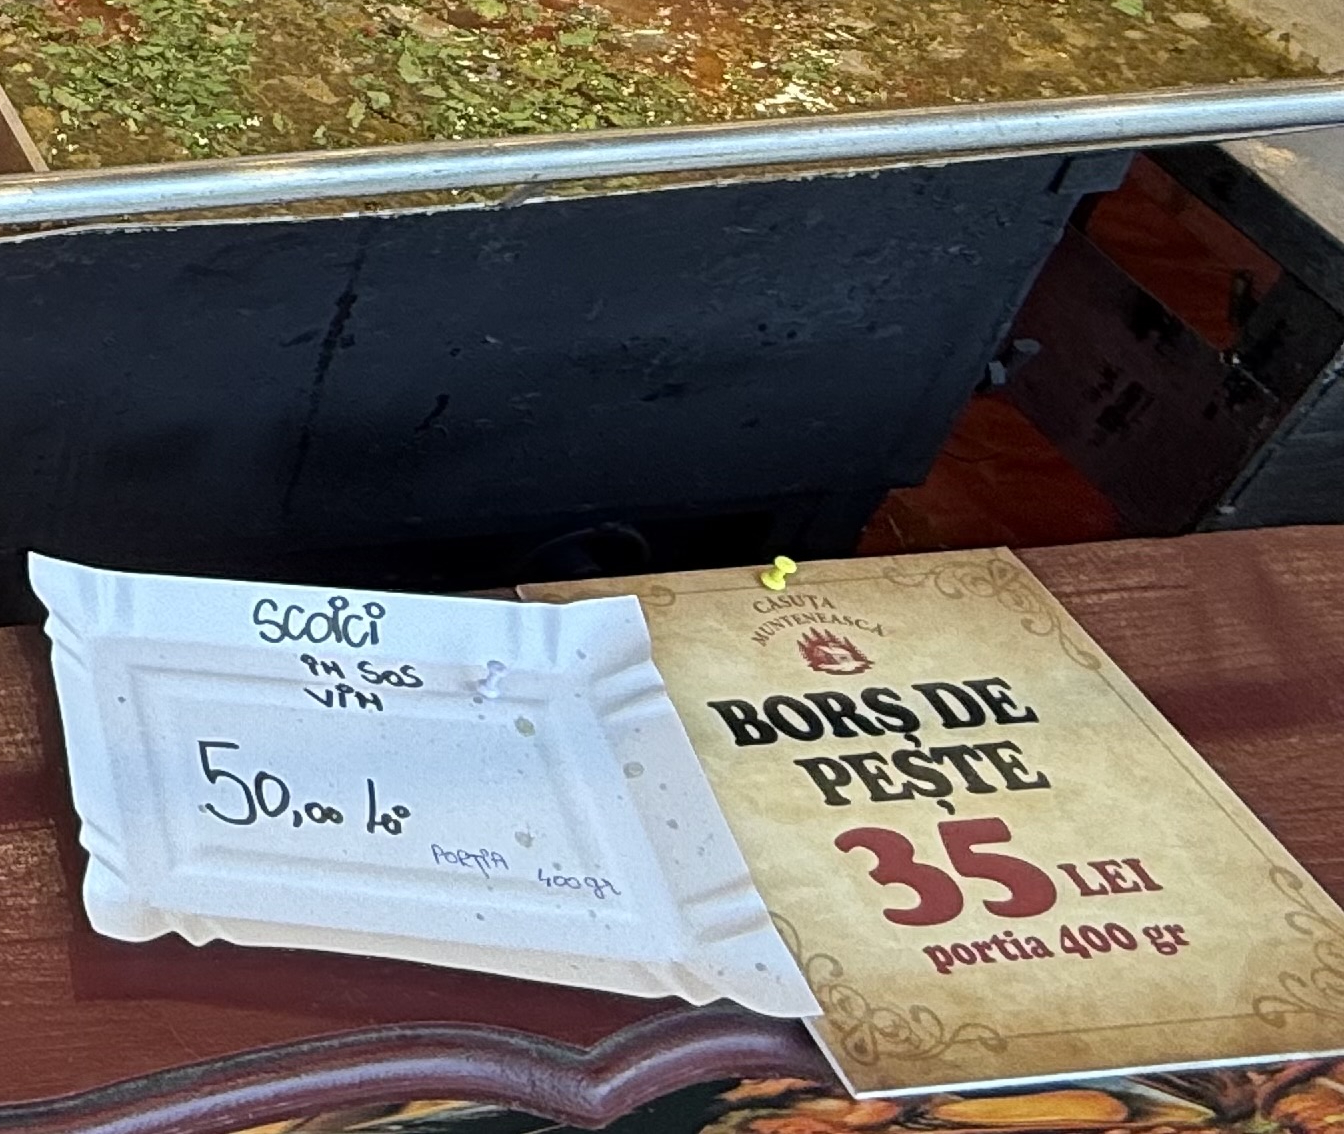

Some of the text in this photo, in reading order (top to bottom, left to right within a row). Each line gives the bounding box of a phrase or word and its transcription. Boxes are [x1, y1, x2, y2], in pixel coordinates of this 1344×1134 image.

[706, 677, 1040, 748] BORȘ DE
[198, 741, 344, 826] 50,00
[793, 740, 1052, 815] PEȘTE
[833, 817, 1164, 926] 35 LEI
[922, 922, 1190, 975] portia 400 gr
